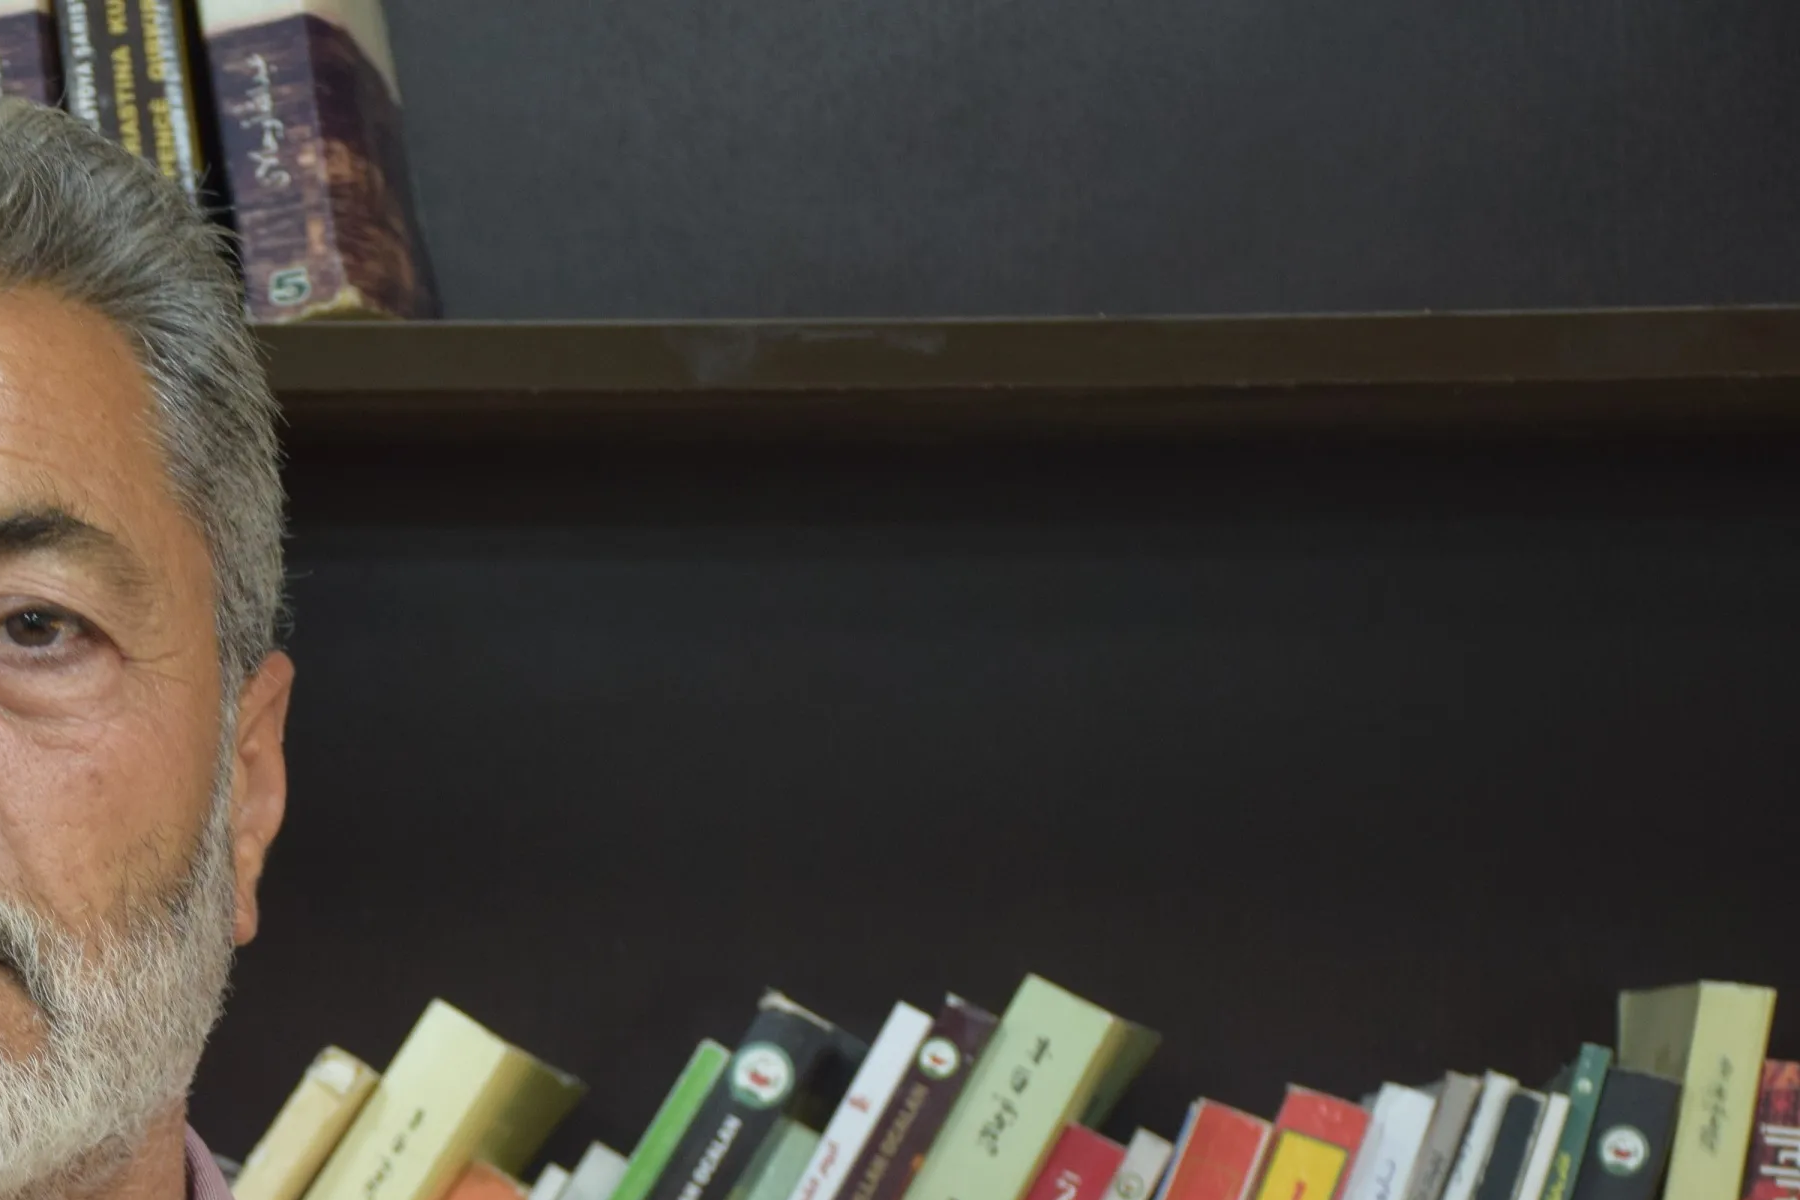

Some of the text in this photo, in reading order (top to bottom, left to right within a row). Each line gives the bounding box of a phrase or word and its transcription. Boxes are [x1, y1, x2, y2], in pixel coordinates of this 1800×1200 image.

[268, 270, 311, 305] 5
[1021, 1031, 1058, 1069] عبد
[1003, 1062, 1033, 1095] الله
